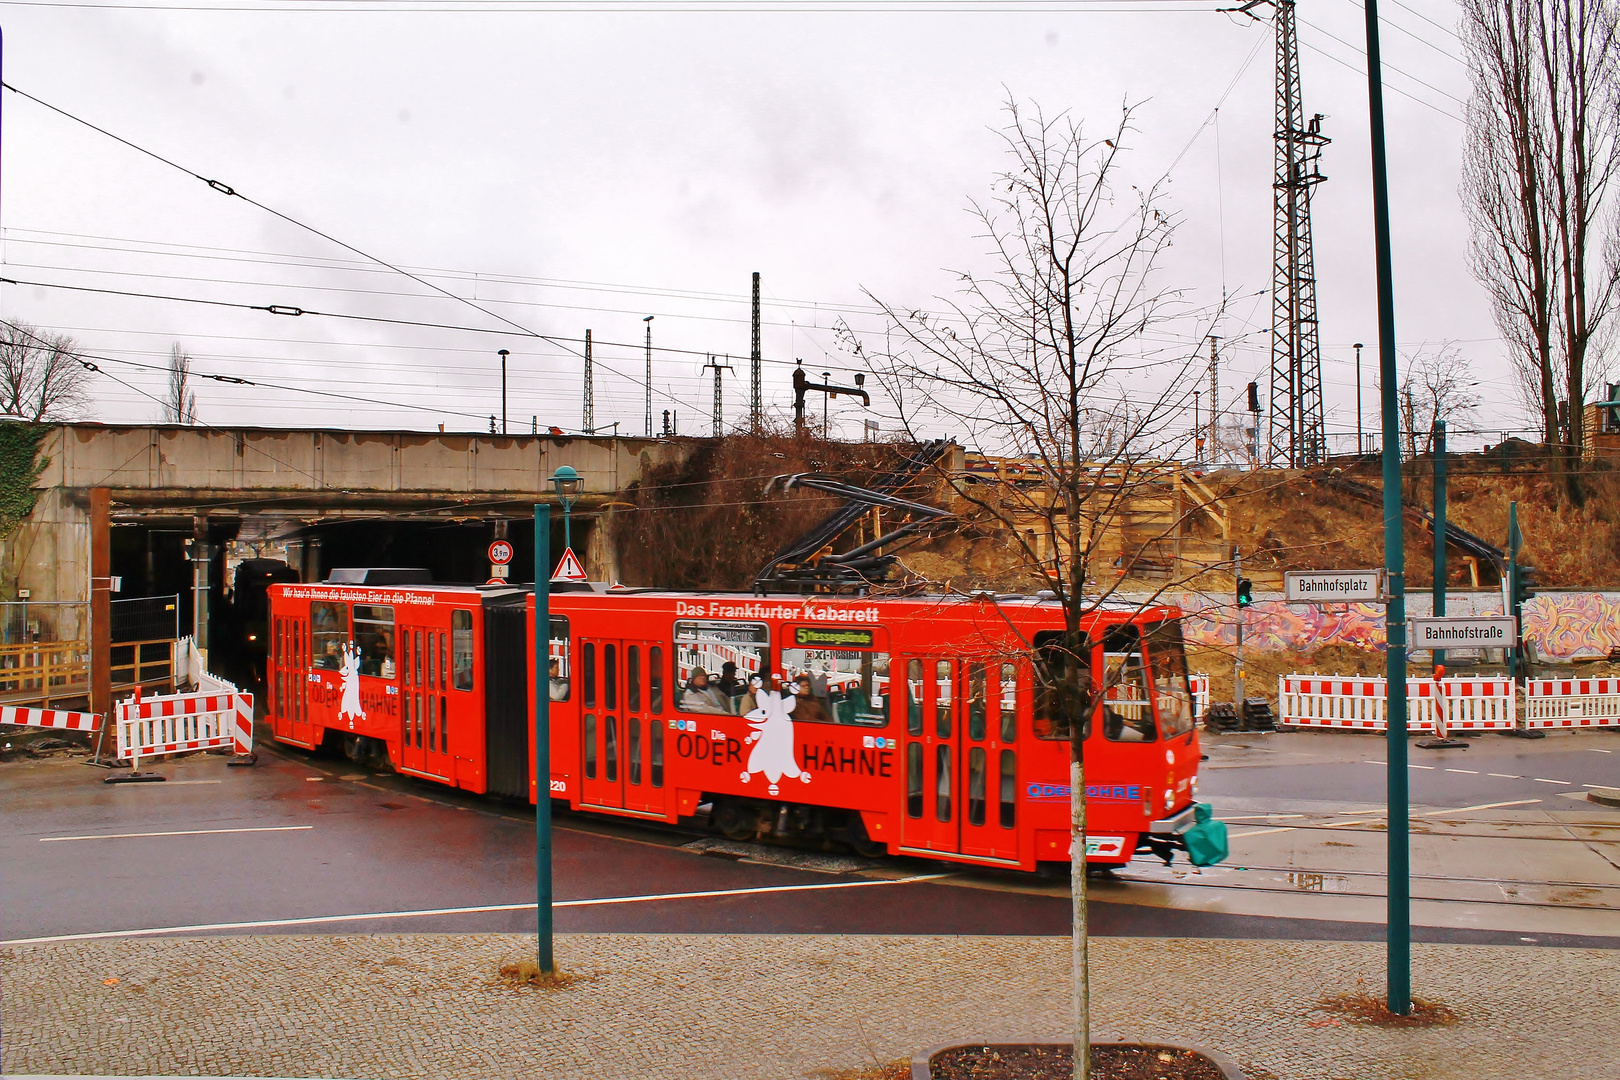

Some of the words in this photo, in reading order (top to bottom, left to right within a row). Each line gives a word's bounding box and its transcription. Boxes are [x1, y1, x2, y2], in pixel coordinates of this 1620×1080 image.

[1299, 578, 1368, 594] Bahnhofsplatz
[283, 587, 293, 598] Wir
[311, 588, 328, 599] Ihnen
[329, 589, 339, 600] die
[340, 590, 367, 602] faulsten
[368, 591, 382, 603] Eier
[383, 592, 391, 603] in
[392, 592, 404, 604] die
[405, 593, 435, 606] Pfanne!
[676, 601, 705, 616] Das
[709, 602, 800, 619] Frankfurter
[804, 606, 880, 622] Kabarett
[797, 629, 808, 643] 5
[1425, 625, 1503, 640] Bahnhofstraße
[312, 685, 339, 708] ODER
[711, 729, 727, 741] Die
[677, 733, 743, 766] ODER
[803, 740, 894, 777] HÄHNE
